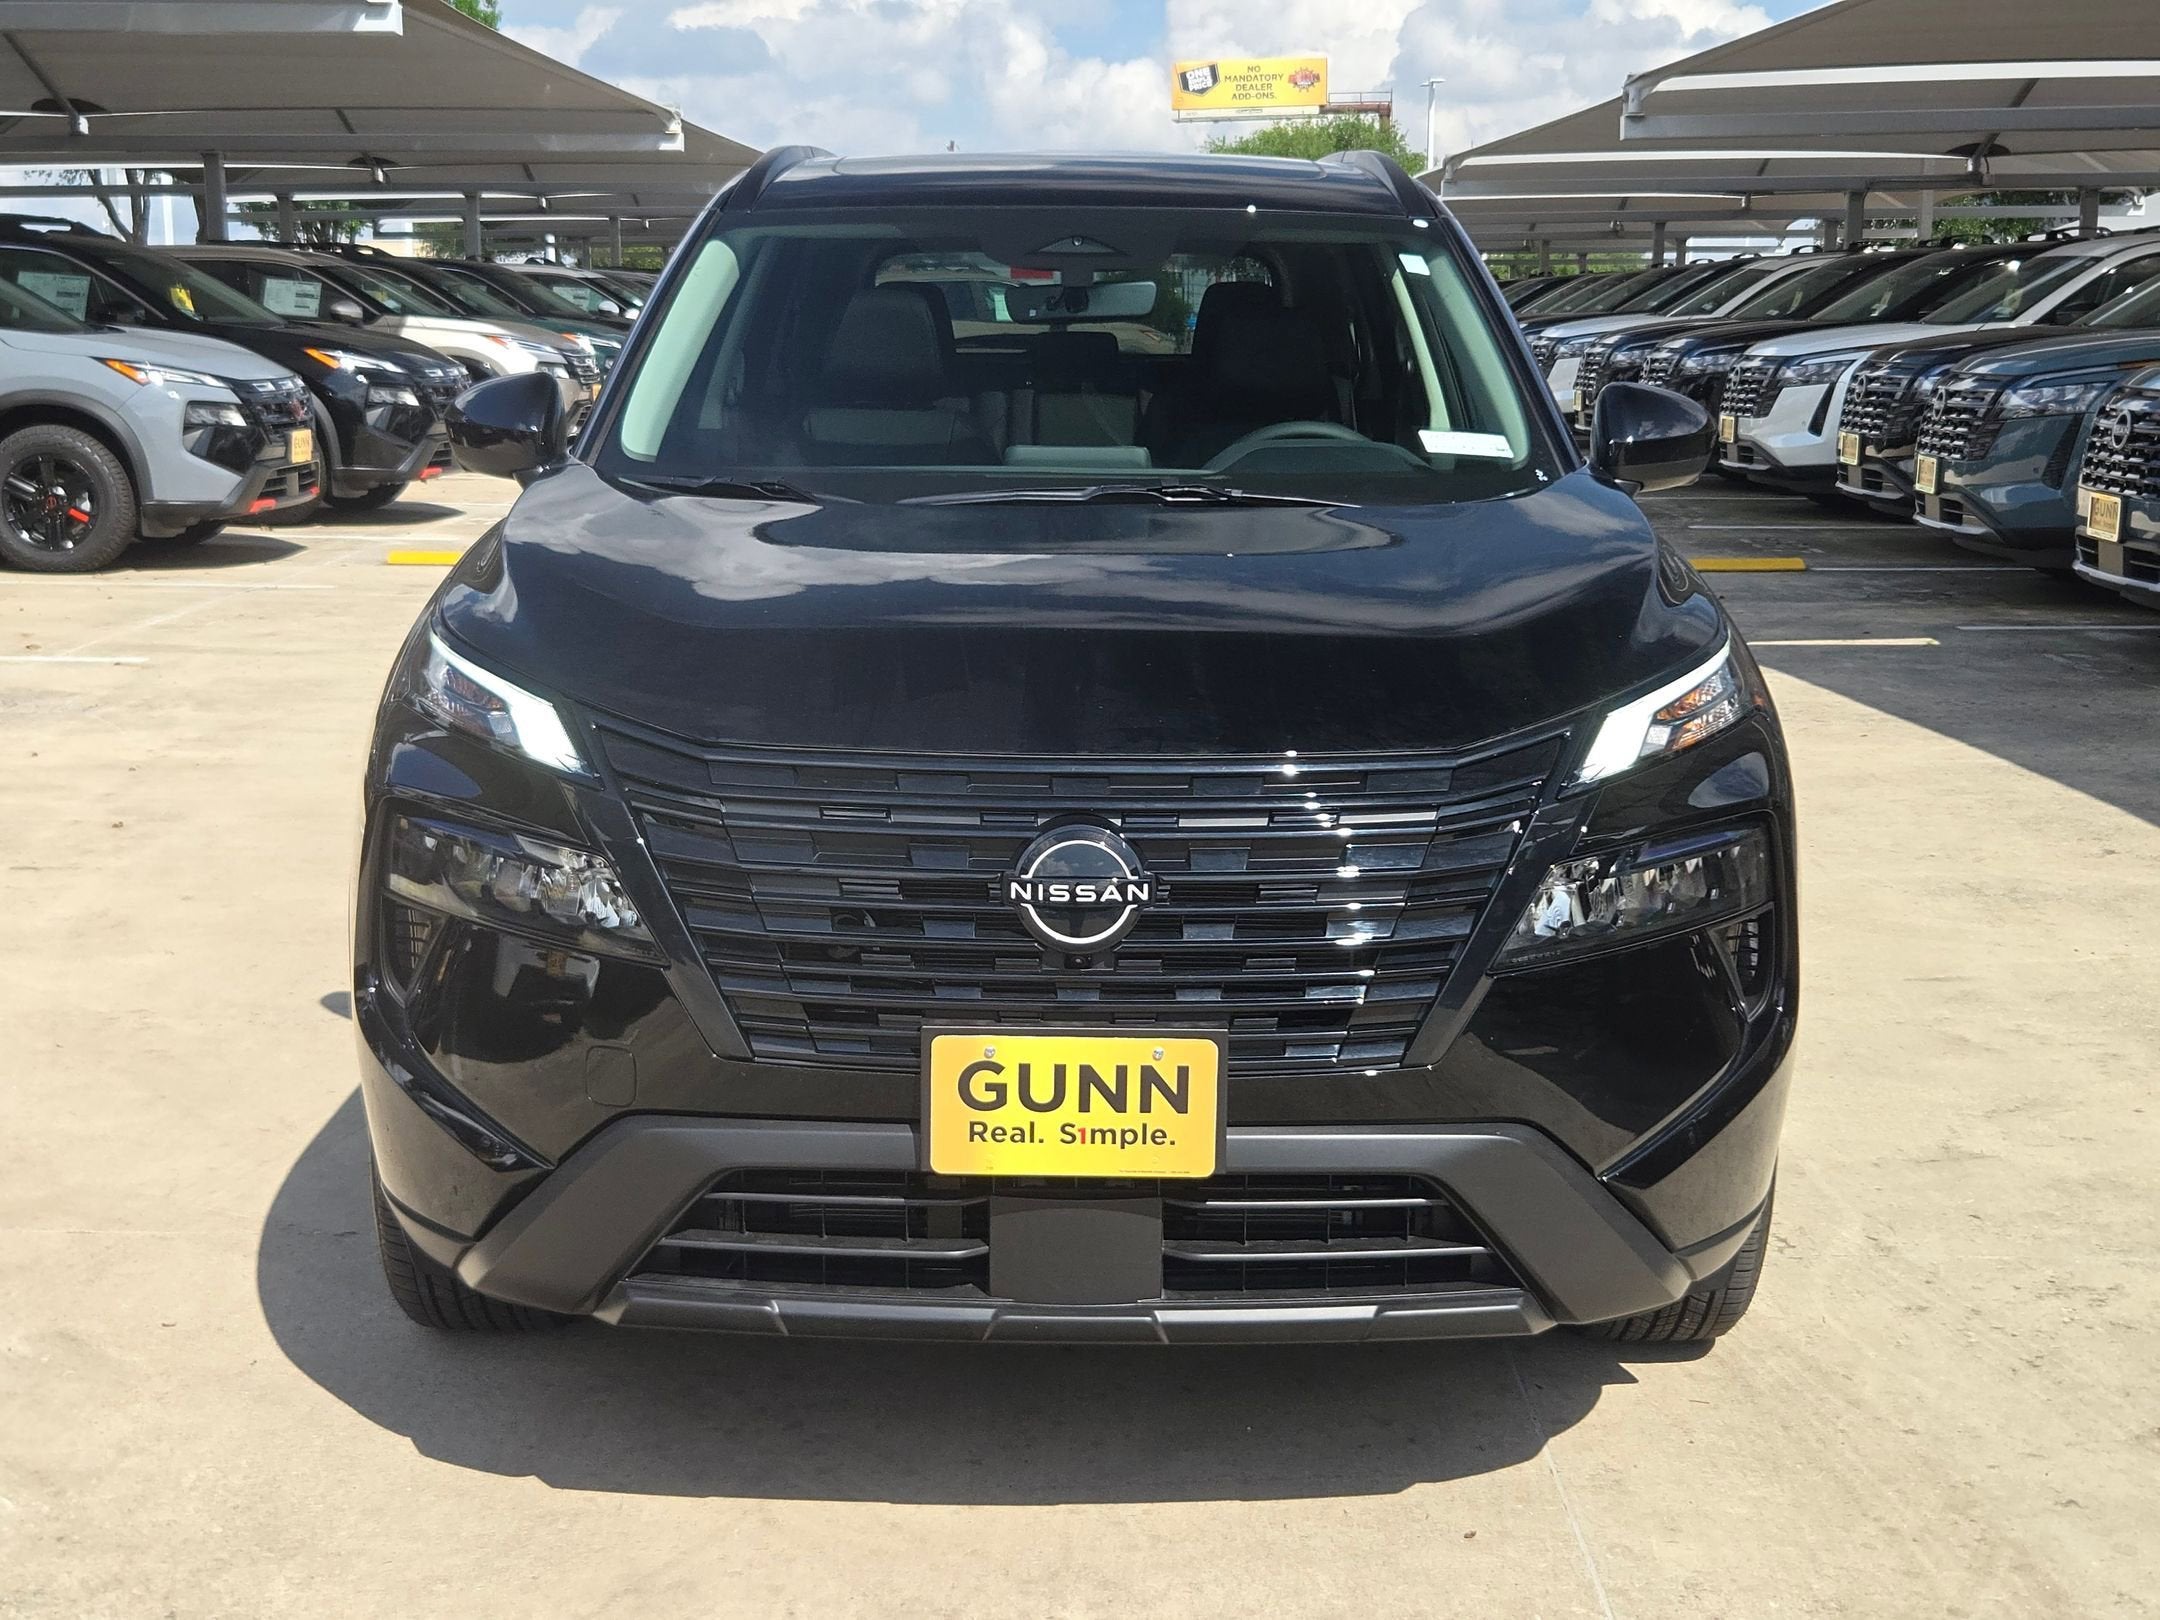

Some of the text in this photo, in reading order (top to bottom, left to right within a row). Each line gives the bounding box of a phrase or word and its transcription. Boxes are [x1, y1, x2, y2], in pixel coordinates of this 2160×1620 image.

[1186, 66, 1211, 79] ONE
[1247, 65, 1261, 73] NO
[1224, 73, 1284, 82] MANDATORY
[1188, 79, 1213, 92] PRICE
[1235, 83, 1273, 91] DEALER
[1231, 92, 1278, 100] ADD-ONS.
[1010, 882, 1149, 902] NISSAN
[957, 1060, 1190, 1115] GUNN
[968, 1120, 1176, 1150] Real. S1mple.
